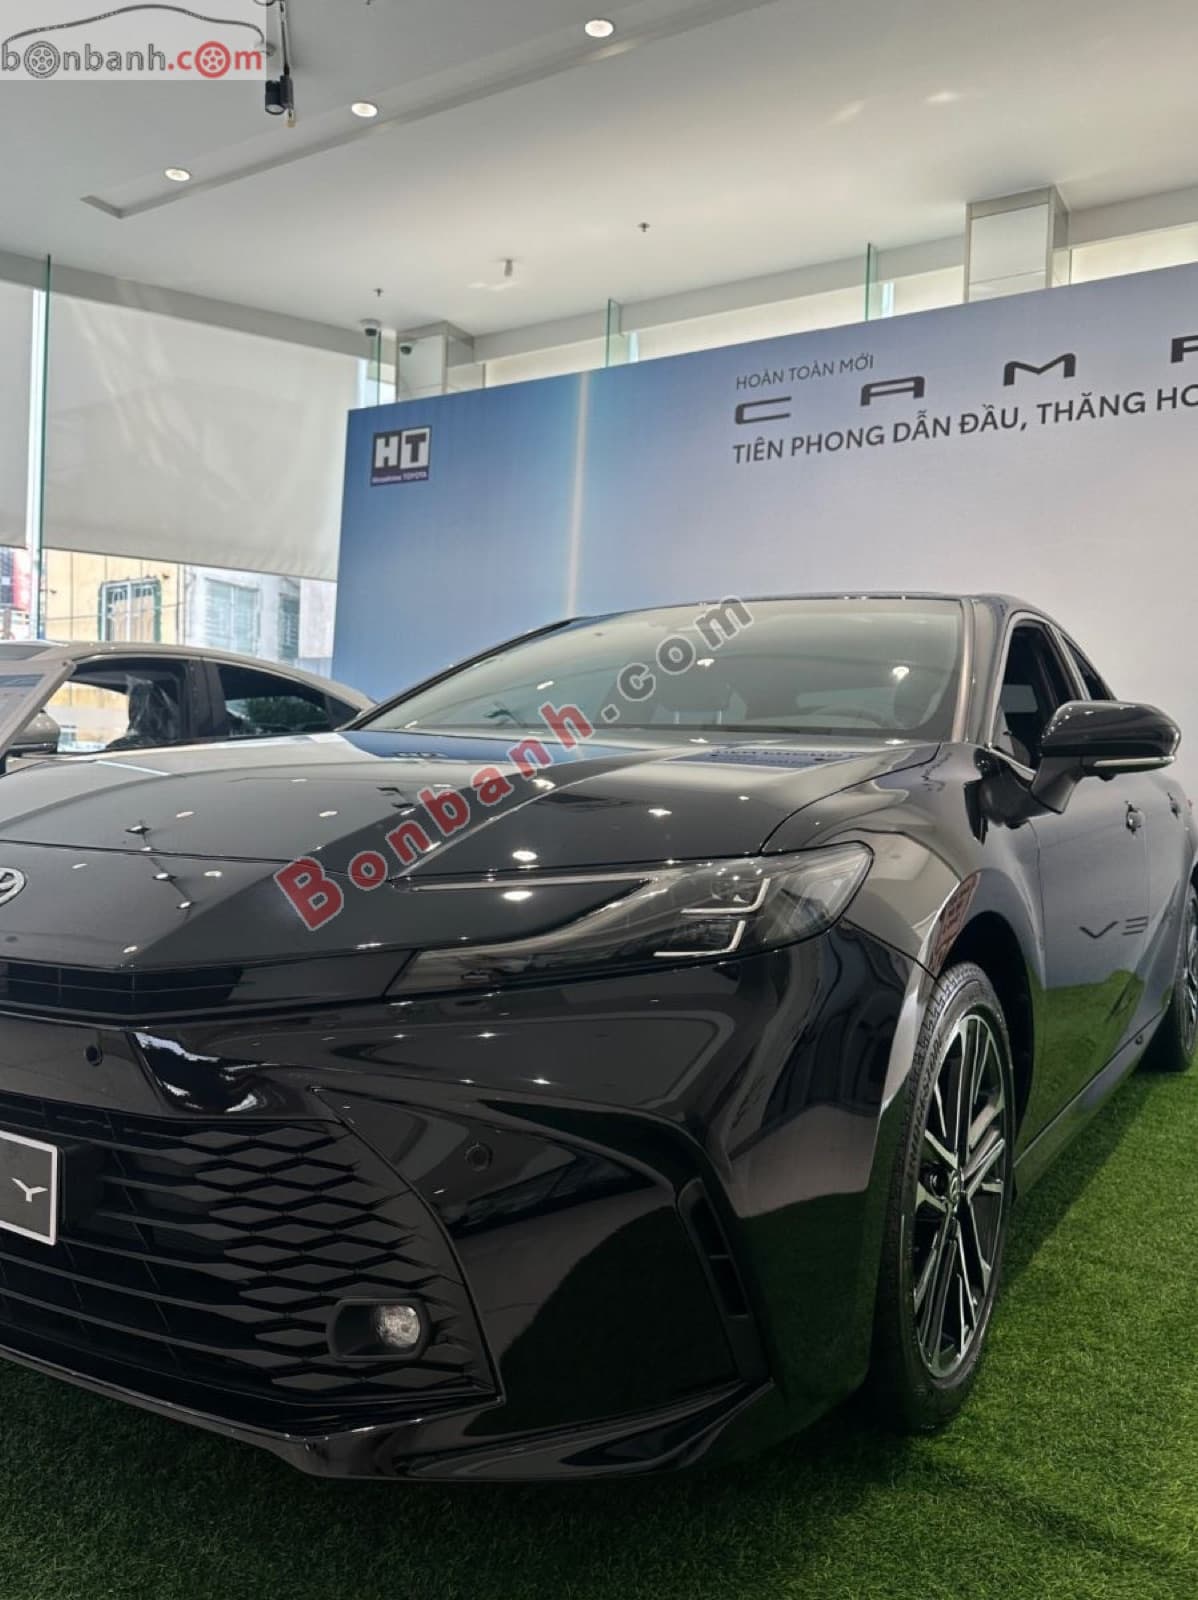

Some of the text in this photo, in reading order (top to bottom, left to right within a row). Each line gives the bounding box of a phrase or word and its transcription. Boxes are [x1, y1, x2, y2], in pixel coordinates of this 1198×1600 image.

[735, 352, 874, 391] HOÀN TOÀN MỚI
[732, 436, 784, 464] TIÊN
[790, 425, 885, 457] PHONG
[892, 409, 951, 443] DẪN
[958, 403, 1027, 434] ĐẦU,
[1036, 391, 1146, 425] THĂNG
[375, 430, 428, 468] HT
